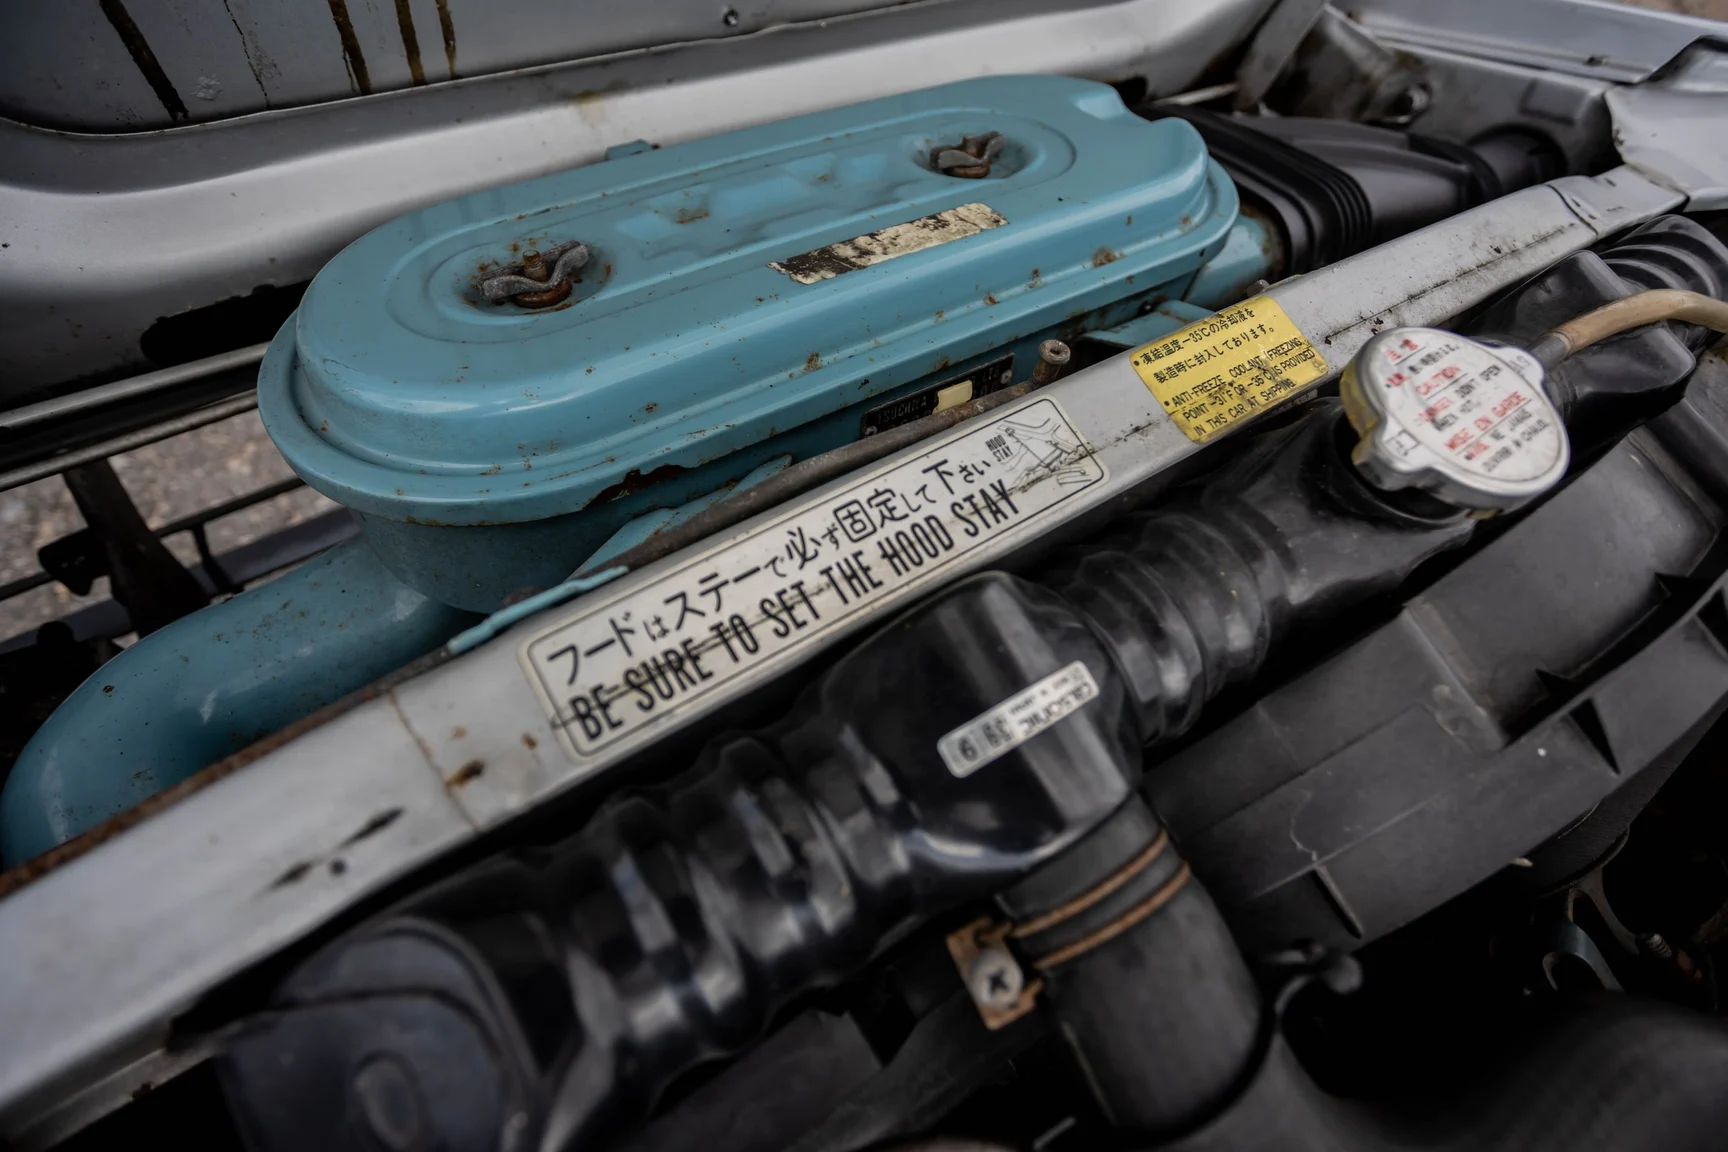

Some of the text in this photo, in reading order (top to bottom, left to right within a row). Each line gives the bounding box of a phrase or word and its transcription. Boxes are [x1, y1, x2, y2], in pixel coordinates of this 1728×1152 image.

[1171, 374, 1226, 408] ANTI-FREEZE
[1228, 355, 1264, 379] COOLANT
[1182, 403, 1210, 422] POINT
[1234, 384, 1248, 396] OR
[1280, 348, 1316, 371] PROVIDED
[1193, 424, 1207, 436] IN
[1205, 413, 1228, 429] THIS
[1228, 403, 1247, 418] CAR
[1247, 395, 1261, 409] AT
[985, 434, 1008, 452] HOOD
[992, 446, 1015, 463] STAY
[547, 459, 990, 686] フードはステーで必ず固定して下さい
[568, 479, 1020, 742] BE SURE TO SET THE HOOD STAY
